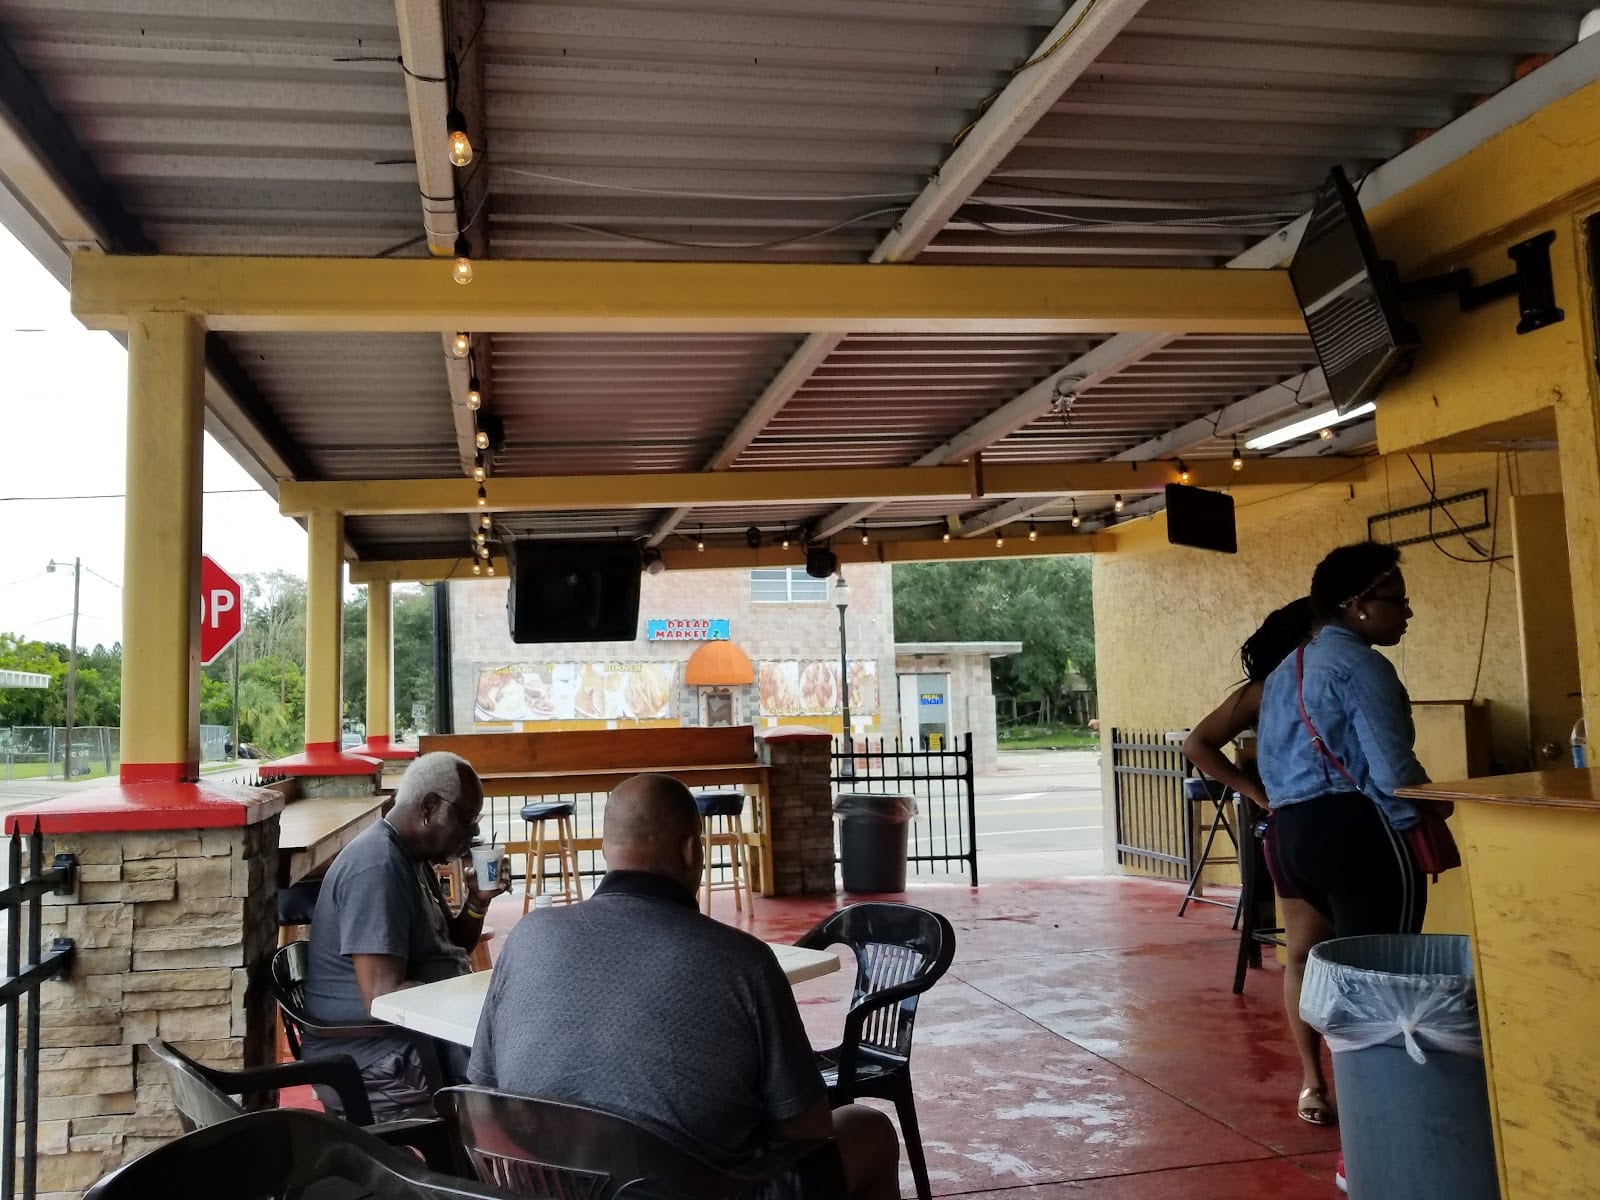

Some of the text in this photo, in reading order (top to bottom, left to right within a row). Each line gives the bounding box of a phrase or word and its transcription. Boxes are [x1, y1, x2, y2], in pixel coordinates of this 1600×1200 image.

[201, 589, 235, 629] P
[667, 620, 710, 629] DREAD
[656, 630, 719, 638] MARKET 2
